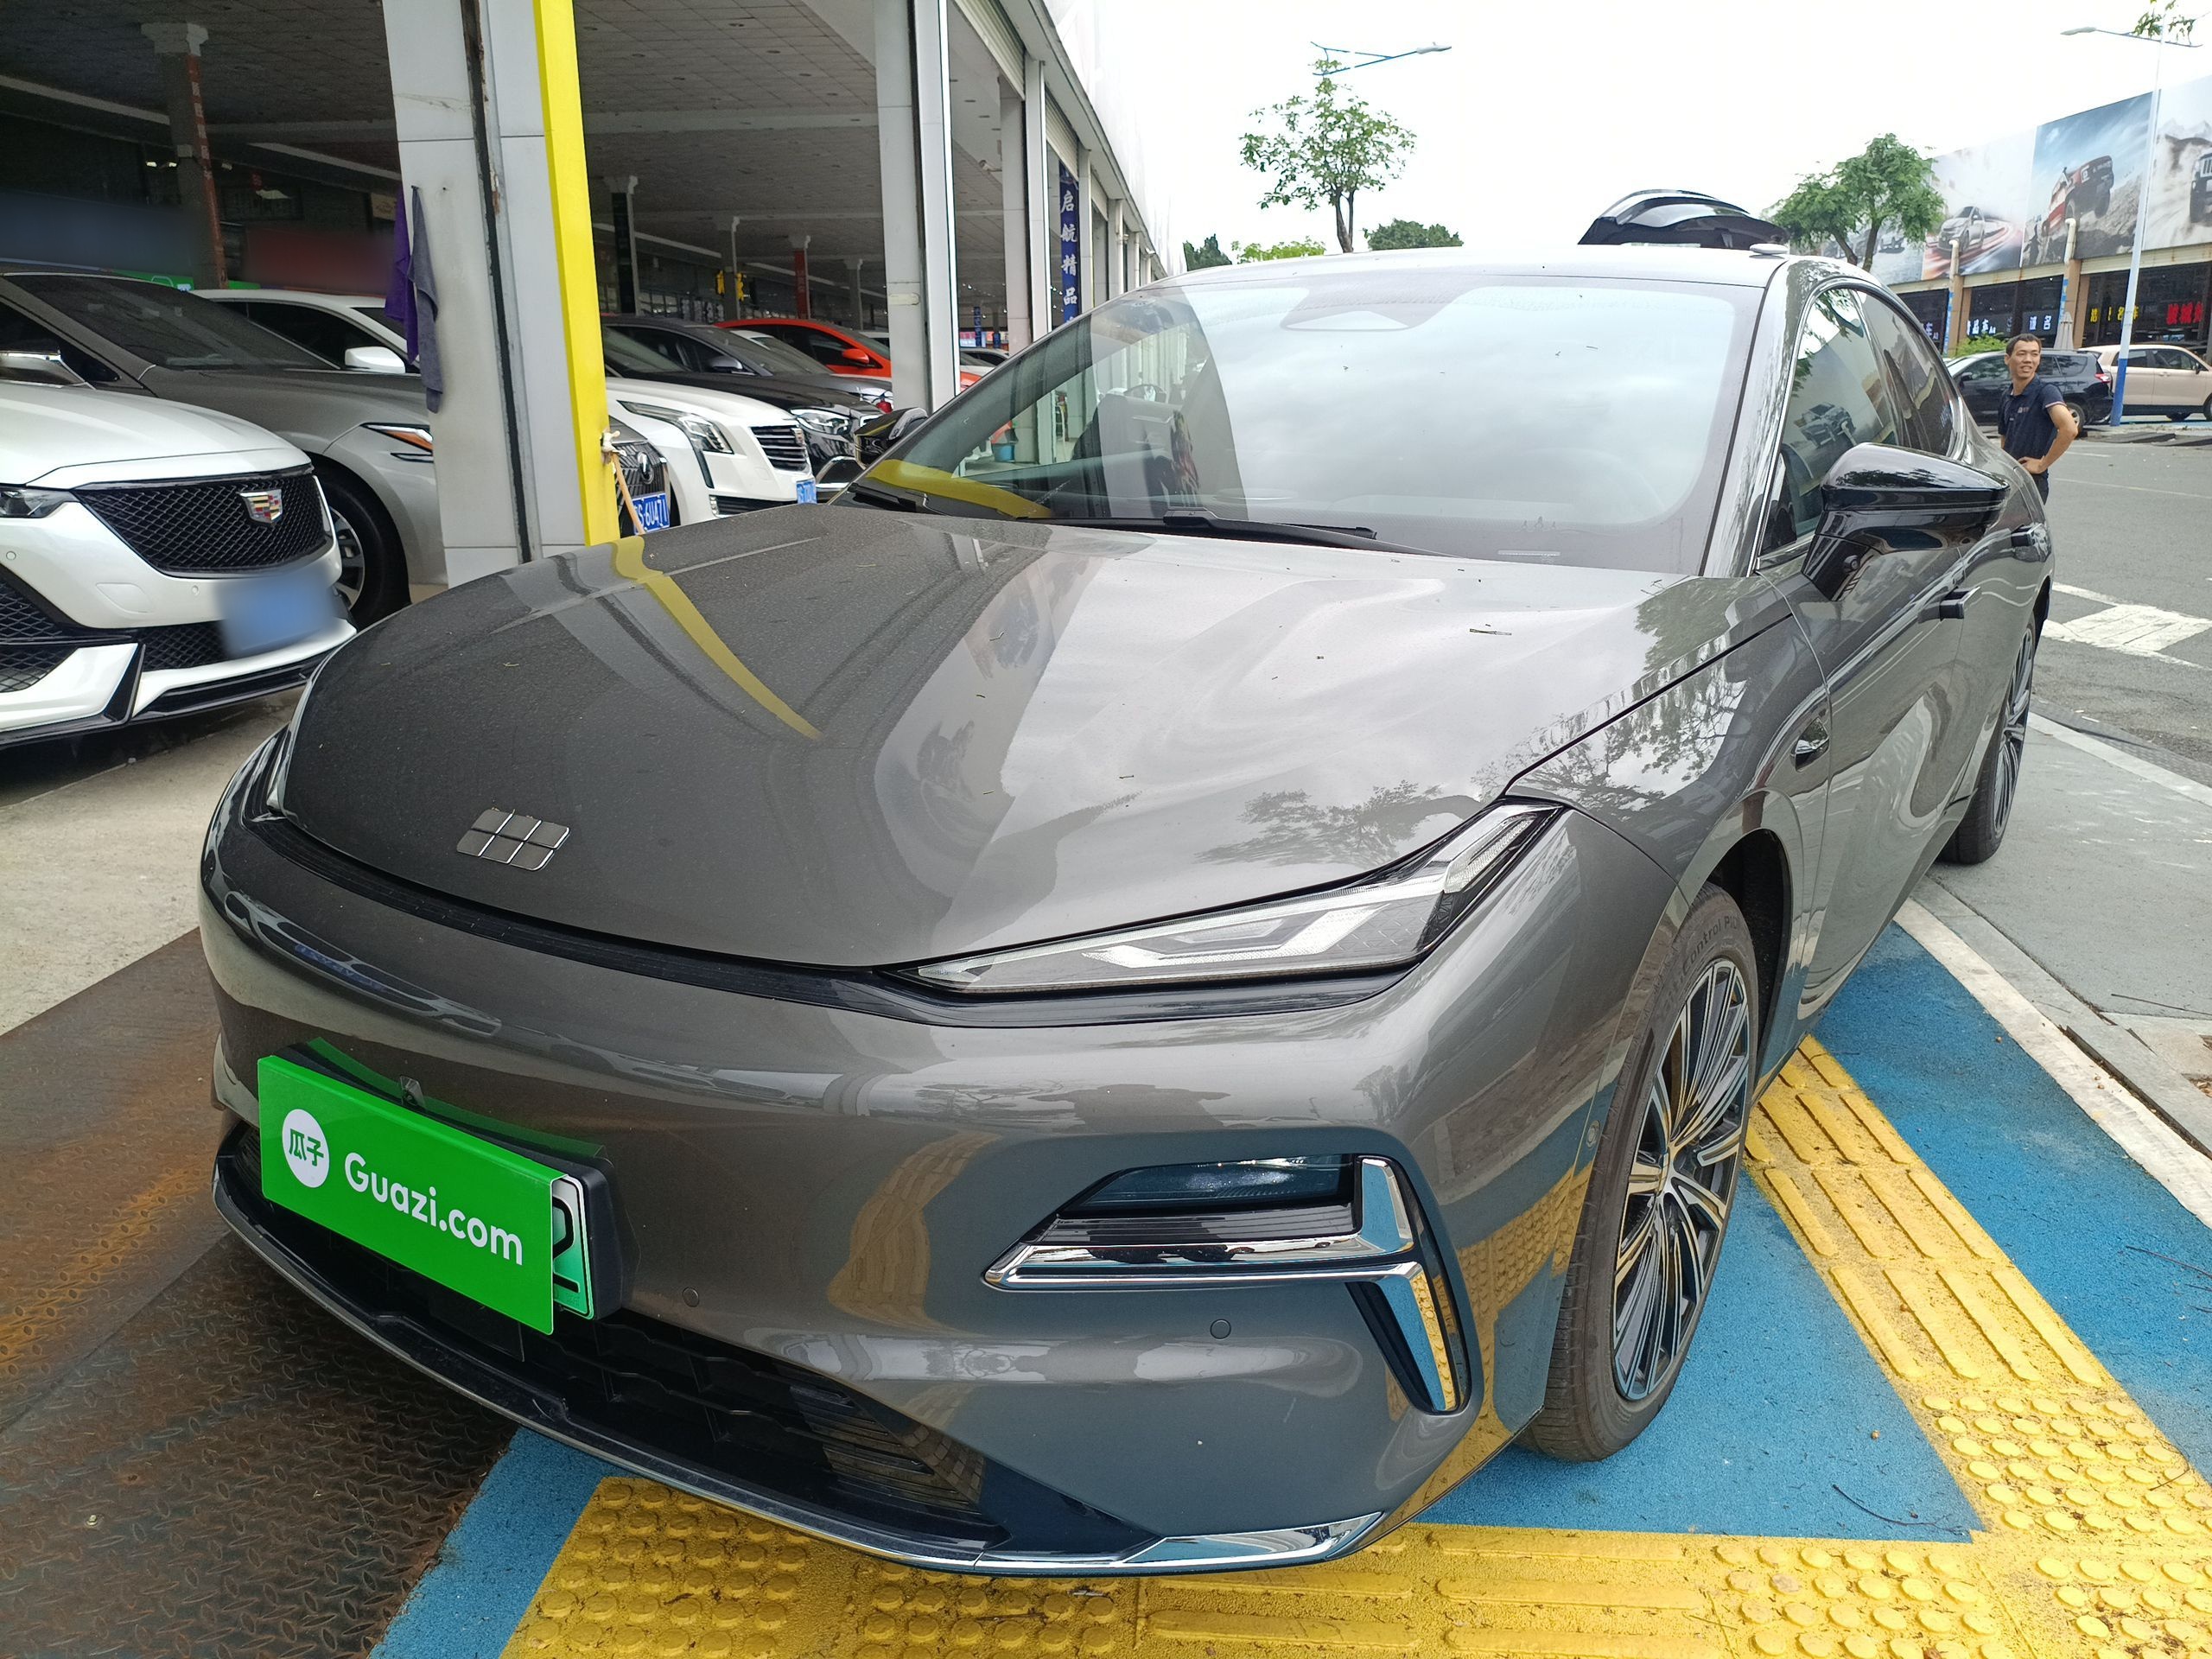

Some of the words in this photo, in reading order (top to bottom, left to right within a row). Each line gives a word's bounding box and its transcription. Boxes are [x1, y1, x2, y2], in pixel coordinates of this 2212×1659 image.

[1060, 189, 1078, 323] 启航精品
[288, 1127, 325, 1166] 瓜子
[344, 1152, 524, 1266] Guazi.com
